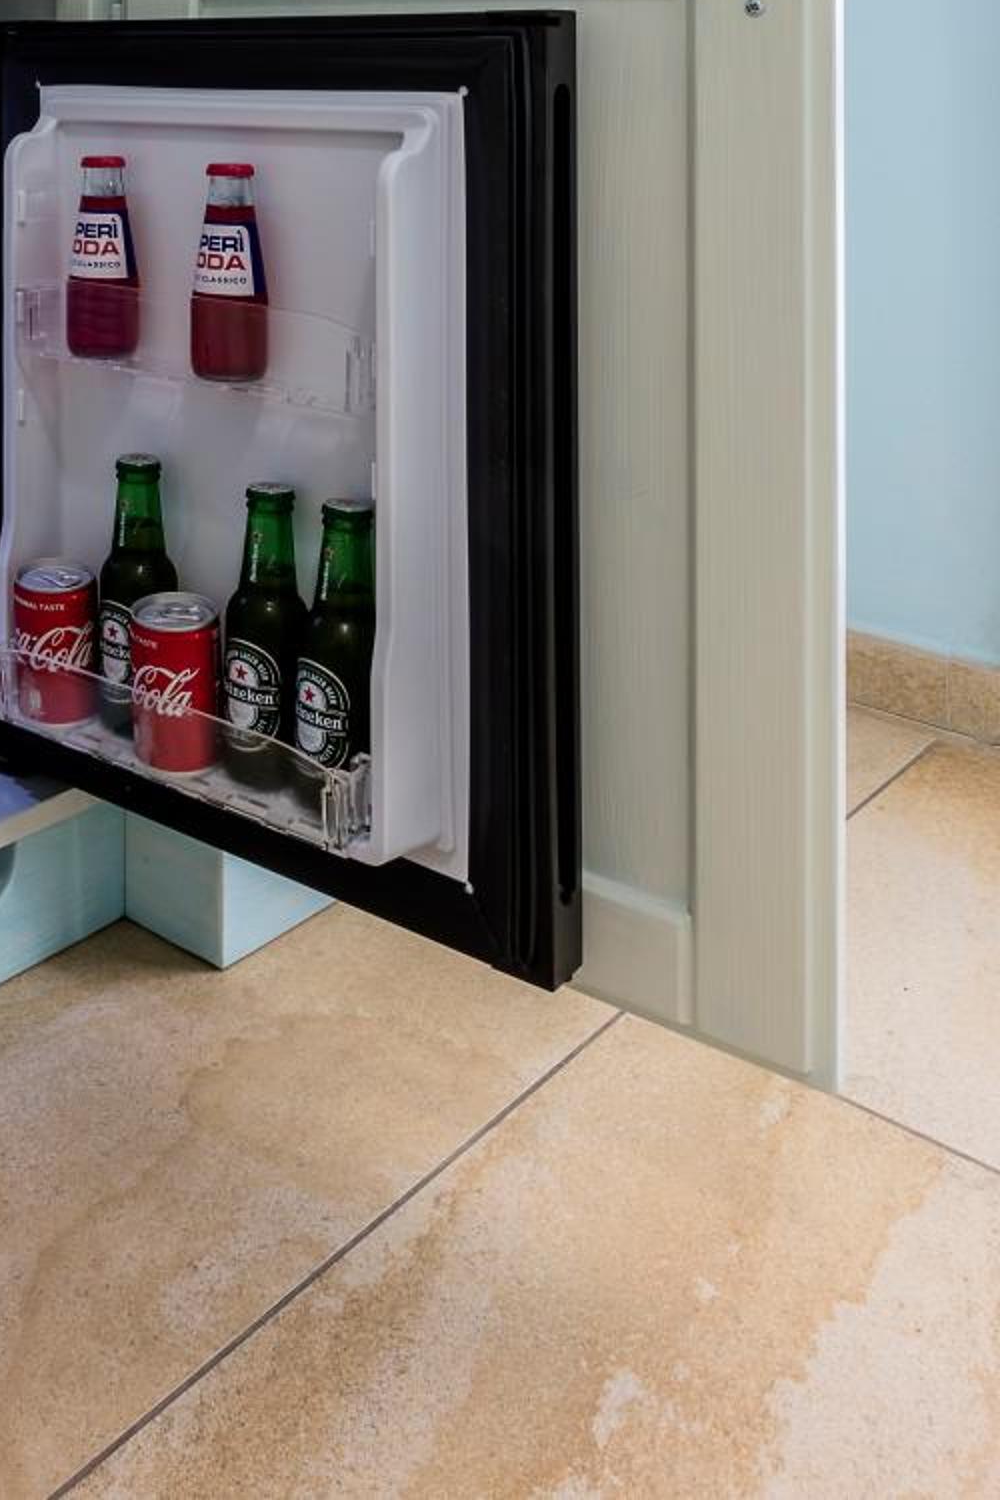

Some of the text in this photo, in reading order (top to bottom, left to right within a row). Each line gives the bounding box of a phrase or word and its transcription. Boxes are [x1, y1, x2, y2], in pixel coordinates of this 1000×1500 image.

[75, 217, 120, 239] PERÌ
[73, 240, 120, 255] ODA
[199, 229, 244, 253] PERÌ
[196, 253, 246, 270] ODA
